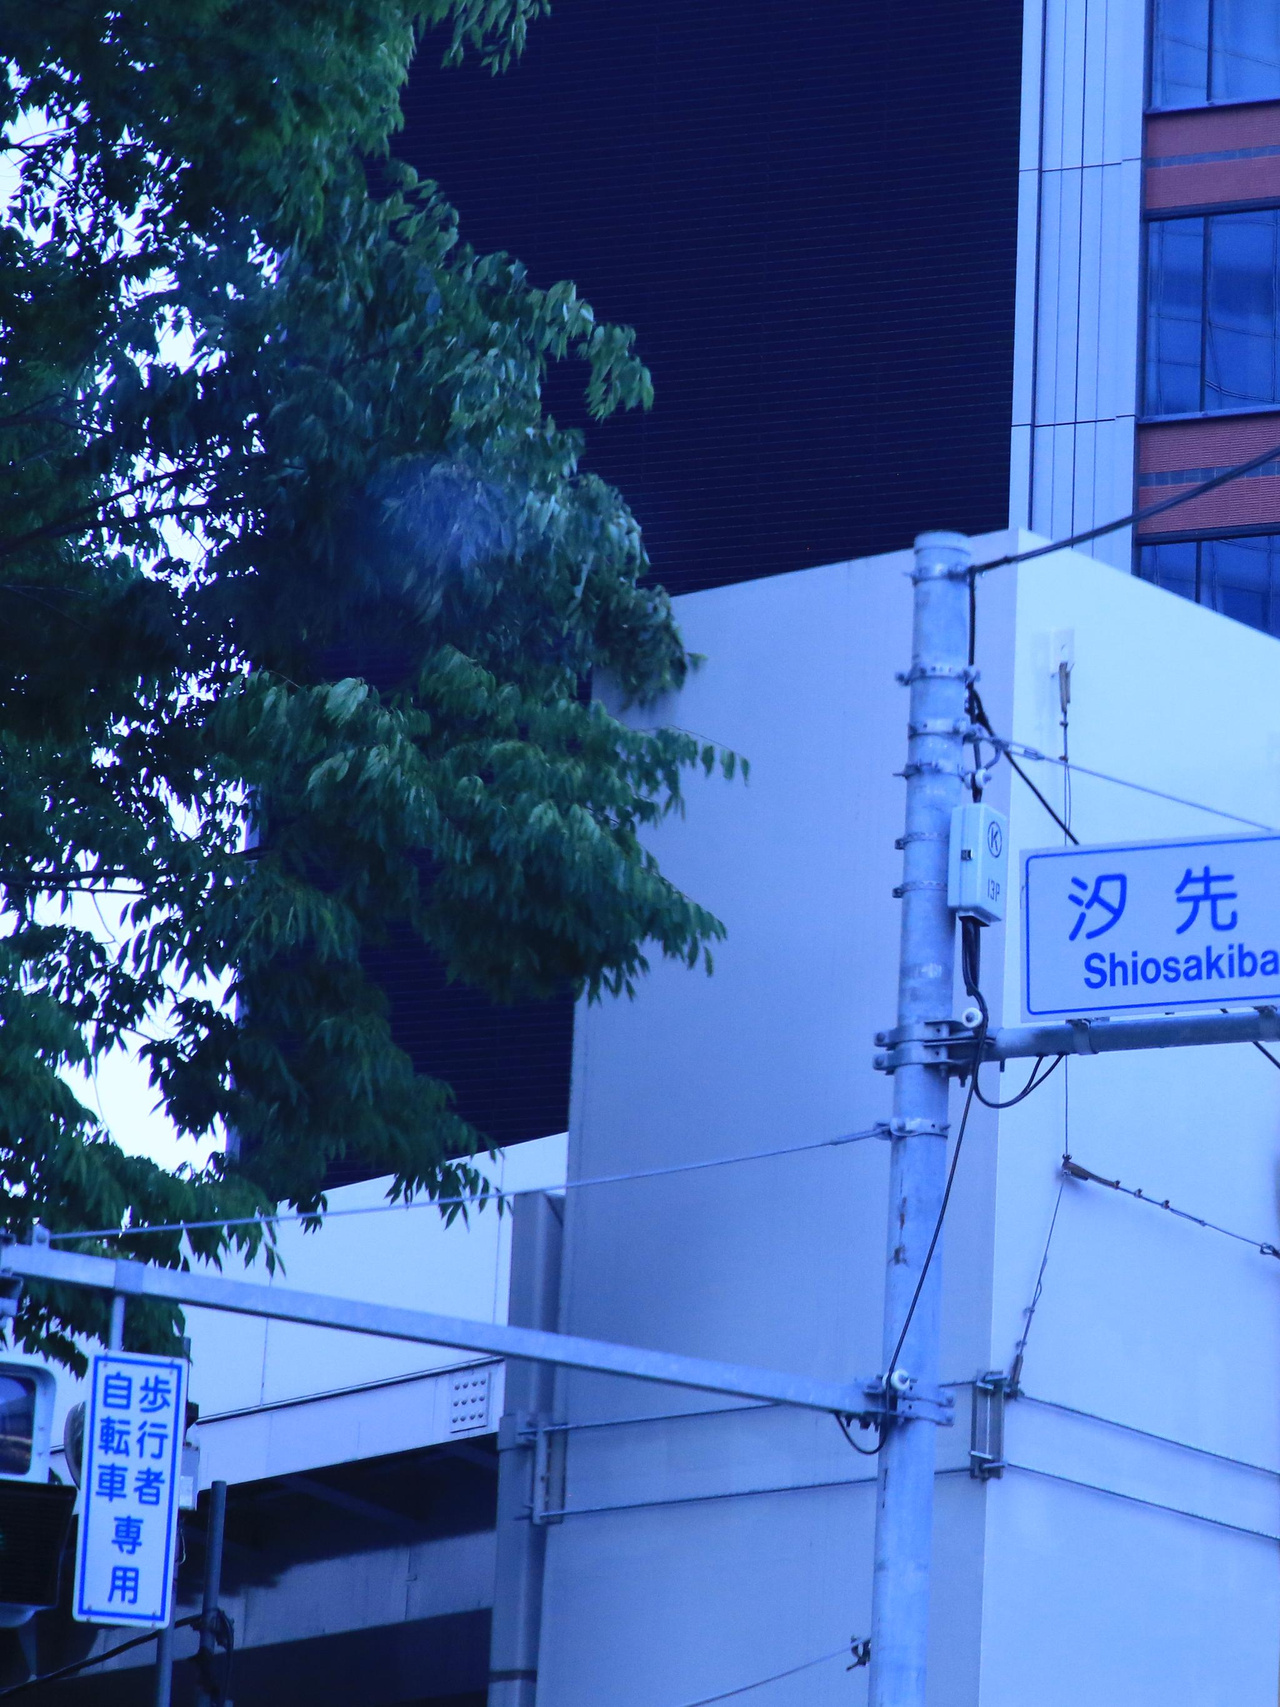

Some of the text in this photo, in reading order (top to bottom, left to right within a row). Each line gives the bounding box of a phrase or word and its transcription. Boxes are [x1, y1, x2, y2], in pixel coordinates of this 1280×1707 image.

[94, 1371, 134, 1503] 自転車
[133, 1374, 172, 1507] 歩行者
[107, 1514, 144, 1605] 専用
